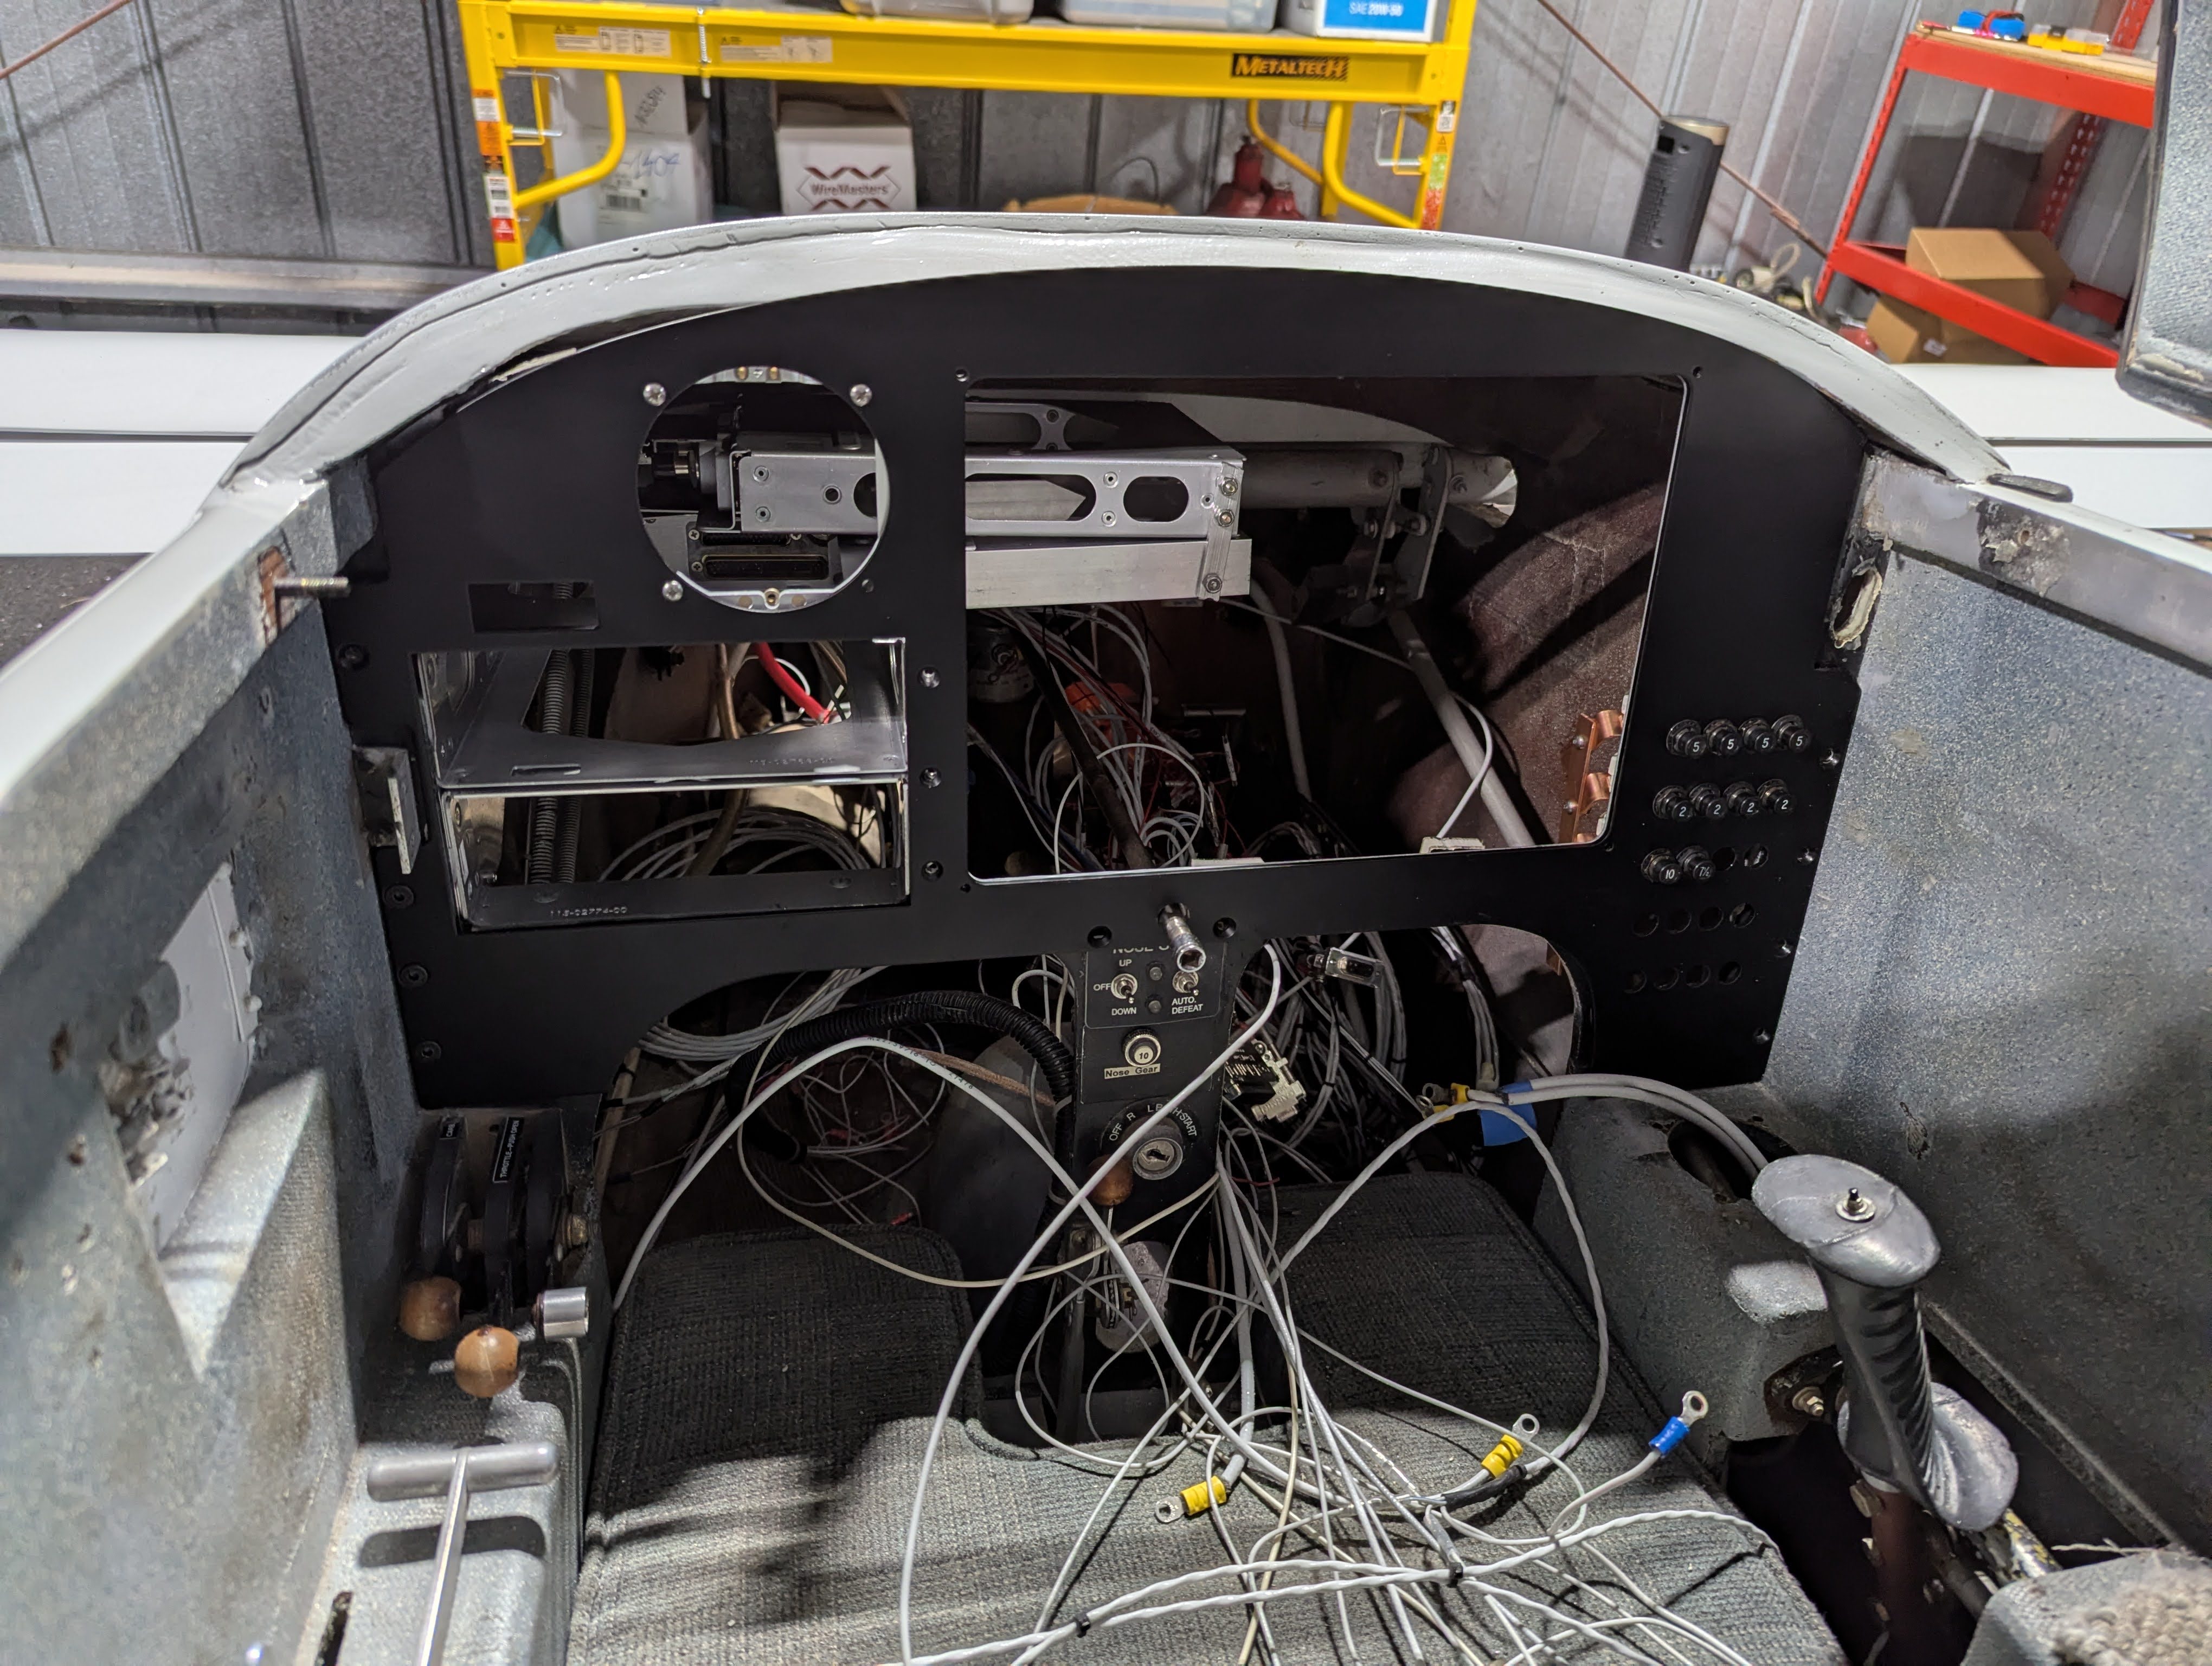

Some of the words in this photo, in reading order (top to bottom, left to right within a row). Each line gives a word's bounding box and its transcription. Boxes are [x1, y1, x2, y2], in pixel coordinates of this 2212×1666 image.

[1349, 2, 1367, 15] SAE
[1235, 55, 1345, 77] METALTECH
[811, 184, 888, 196] WireMasters
[1692, 741, 1700, 752] 5
[1727, 739, 1734, 749] 5
[1761, 738, 1770, 748] 5
[1796, 736, 1803, 746] 5
[1713, 804, 1721, 815] 2
[1747, 803, 1754, 812] 2
[1781, 799, 1789, 810] 2
[1679, 806, 1687, 817] 2
[1665, 869, 1675, 879] 10
[1119, 959, 1133, 967] UP
[1093, 983, 1111, 991] OFF
[1172, 997, 1197, 1005] AUTO.
[1111, 1007, 1137, 1016] DOWN
[1172, 1003, 1204, 1015] DEFEAT
[1155, 1103, 1182, 1117] BH
[1126, 1112, 1136, 1121] R
[1179, 1112, 1197, 1137] START
[1109, 1123, 1122, 1141] OFF
